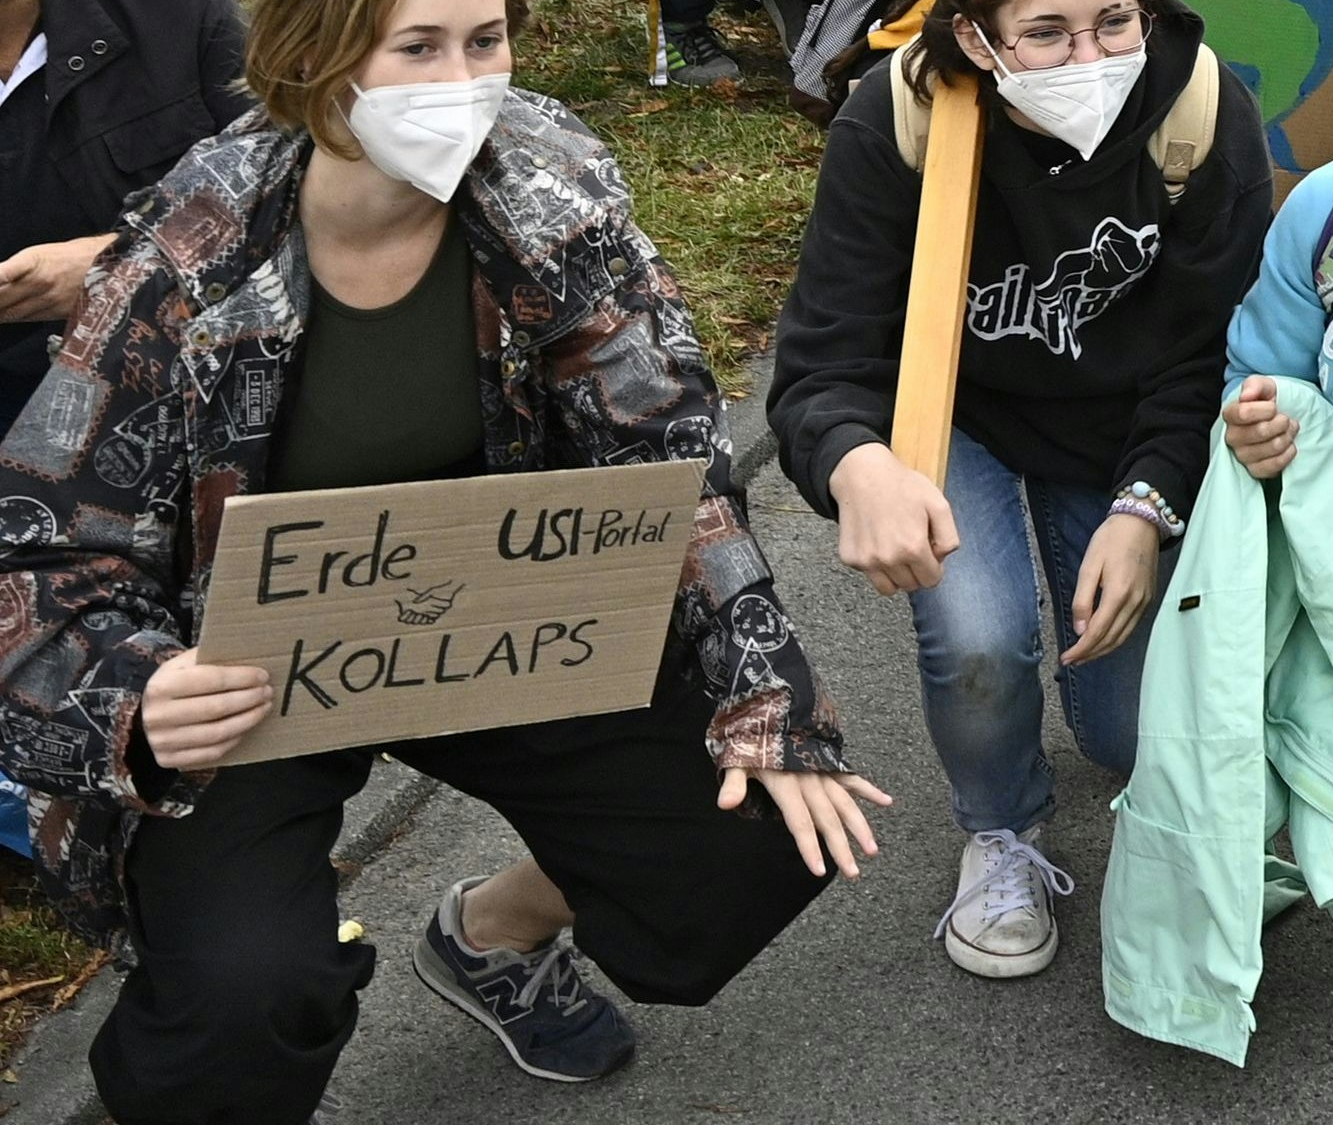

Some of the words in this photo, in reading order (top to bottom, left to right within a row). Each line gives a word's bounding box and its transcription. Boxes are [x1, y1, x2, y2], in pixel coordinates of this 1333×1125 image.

[256, 509, 417, 605] Erde
[497, 507, 672, 562] USI-Portal
[280, 619, 599, 717] KOLLAPS
